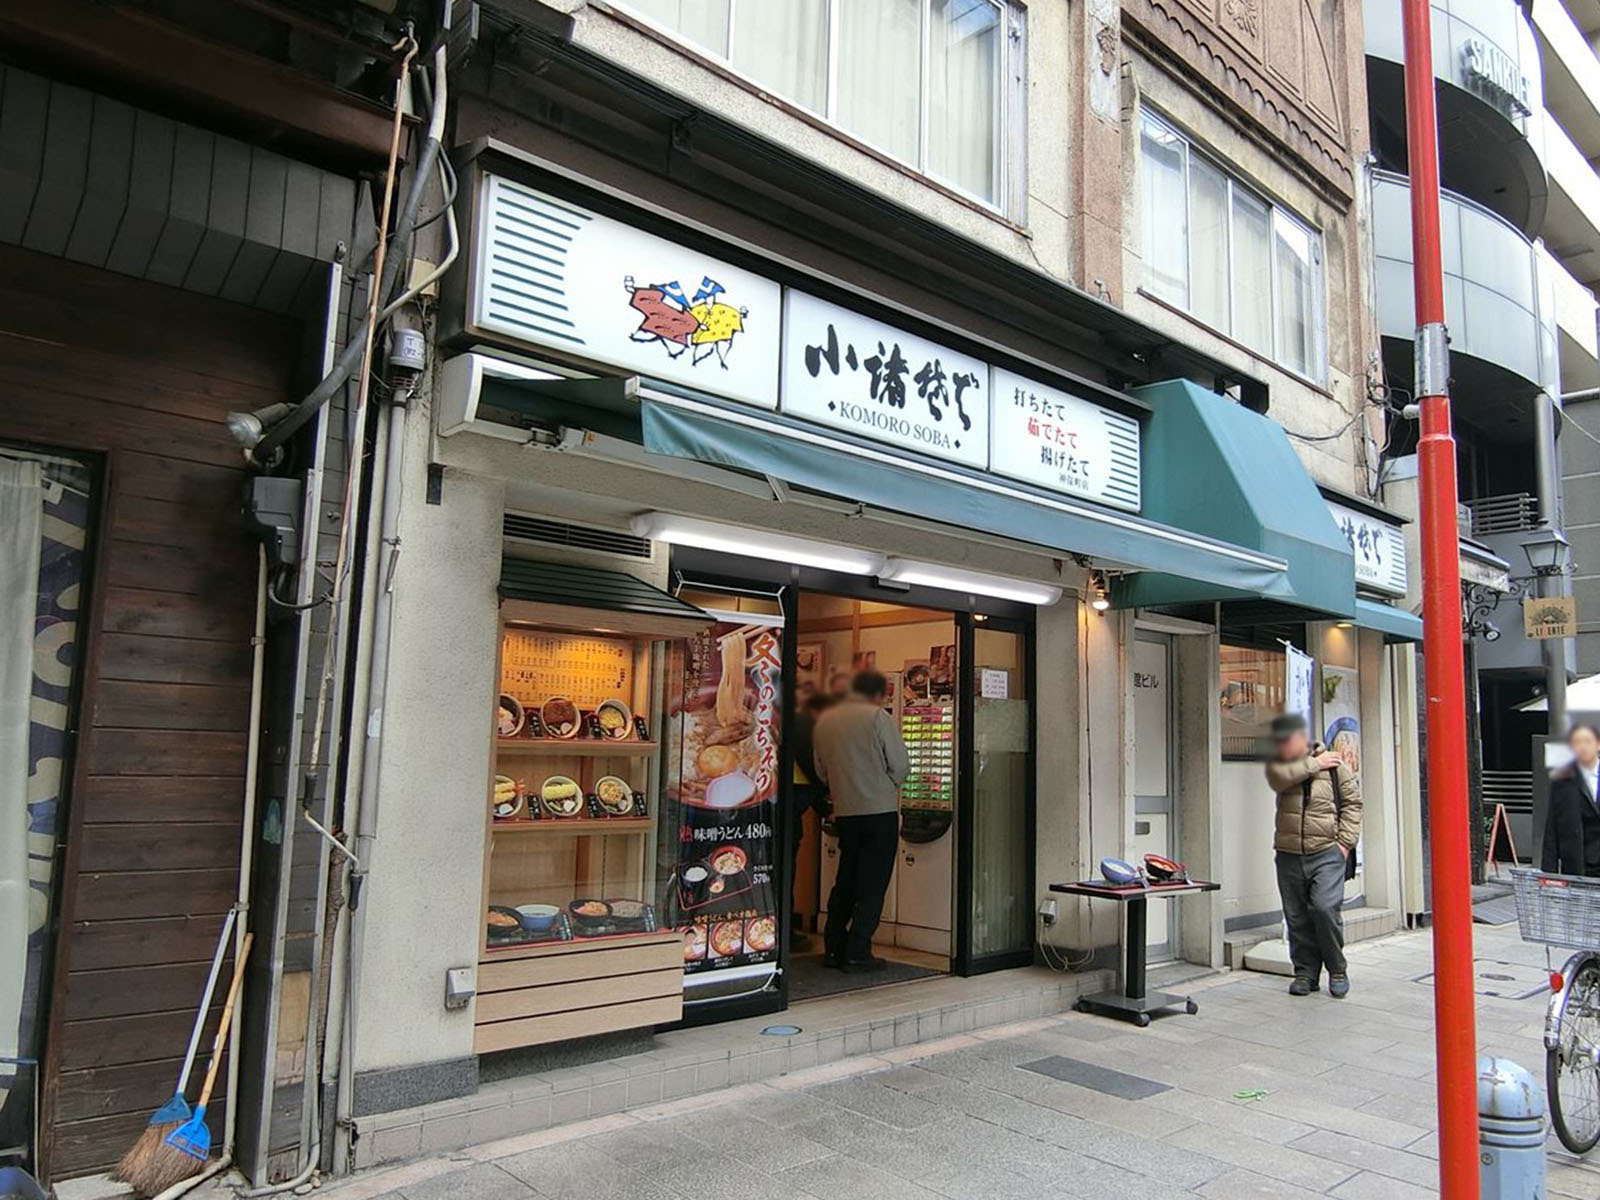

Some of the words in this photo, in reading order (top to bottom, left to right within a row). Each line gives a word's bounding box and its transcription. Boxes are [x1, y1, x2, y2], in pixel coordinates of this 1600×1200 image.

[804, 323, 980, 432] 小諸そば
[839, 400, 911, 436] KOMORO
[913, 424, 951, 449] SOBA
[1014, 387, 1065, 421] 打ちたて
[1027, 416, 1078, 449] 茹でたて
[1040, 445, 1090, 477] 揚げたて
[751, 632, 781, 791] 冬のごちそう
